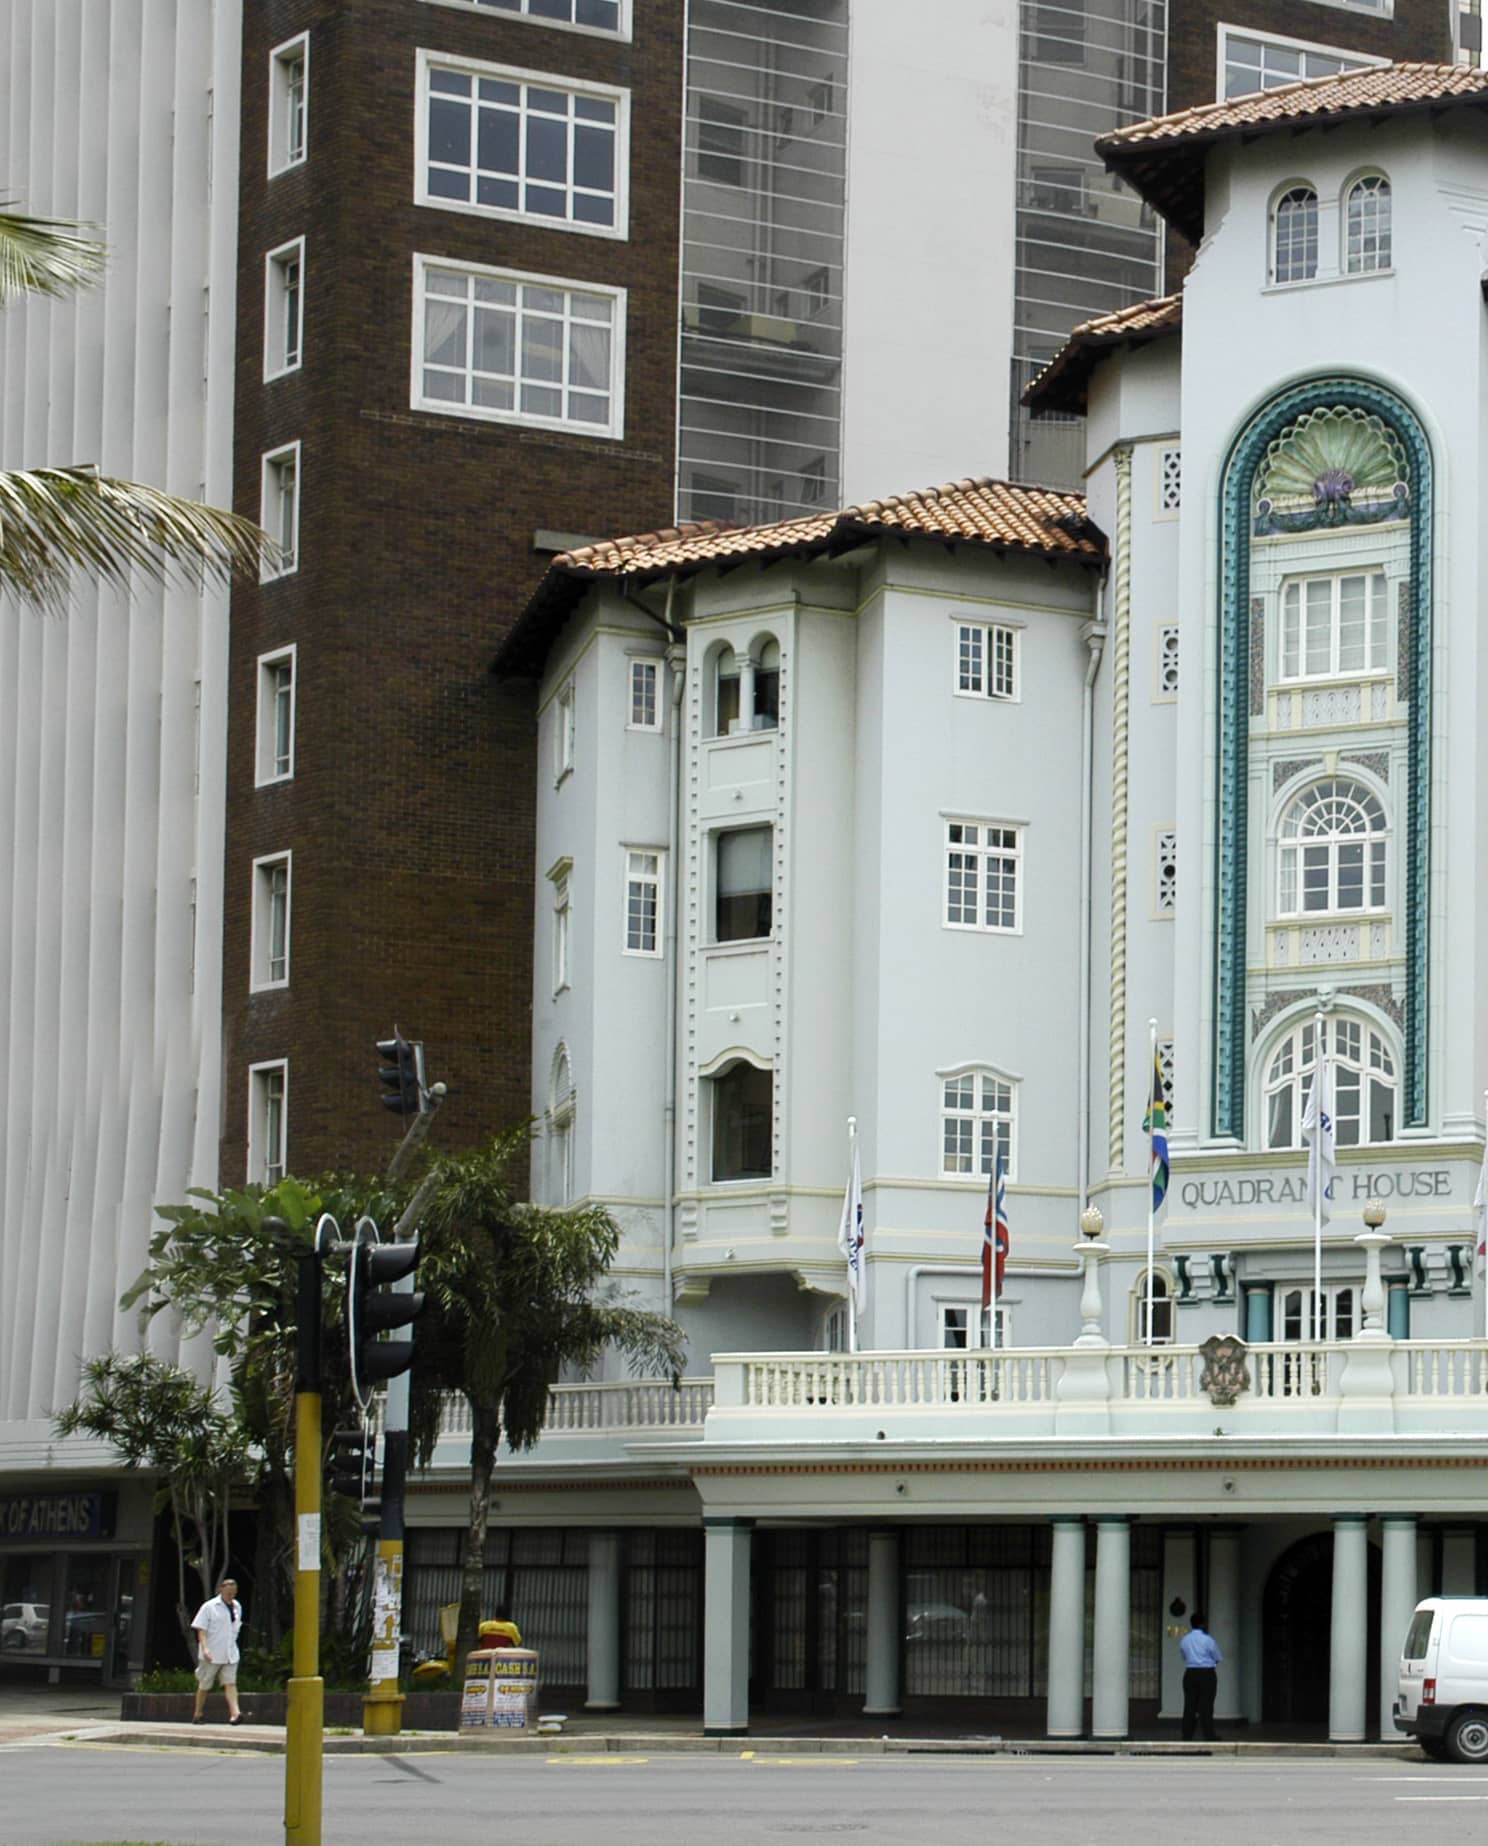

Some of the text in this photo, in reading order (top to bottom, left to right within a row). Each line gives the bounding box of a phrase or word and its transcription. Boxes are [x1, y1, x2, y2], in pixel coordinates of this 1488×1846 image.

[1352, 1170, 1451, 1199] HOUSE
[8, 1500, 29, 1533] OF
[28, 1498, 89, 1533] ATHENS
